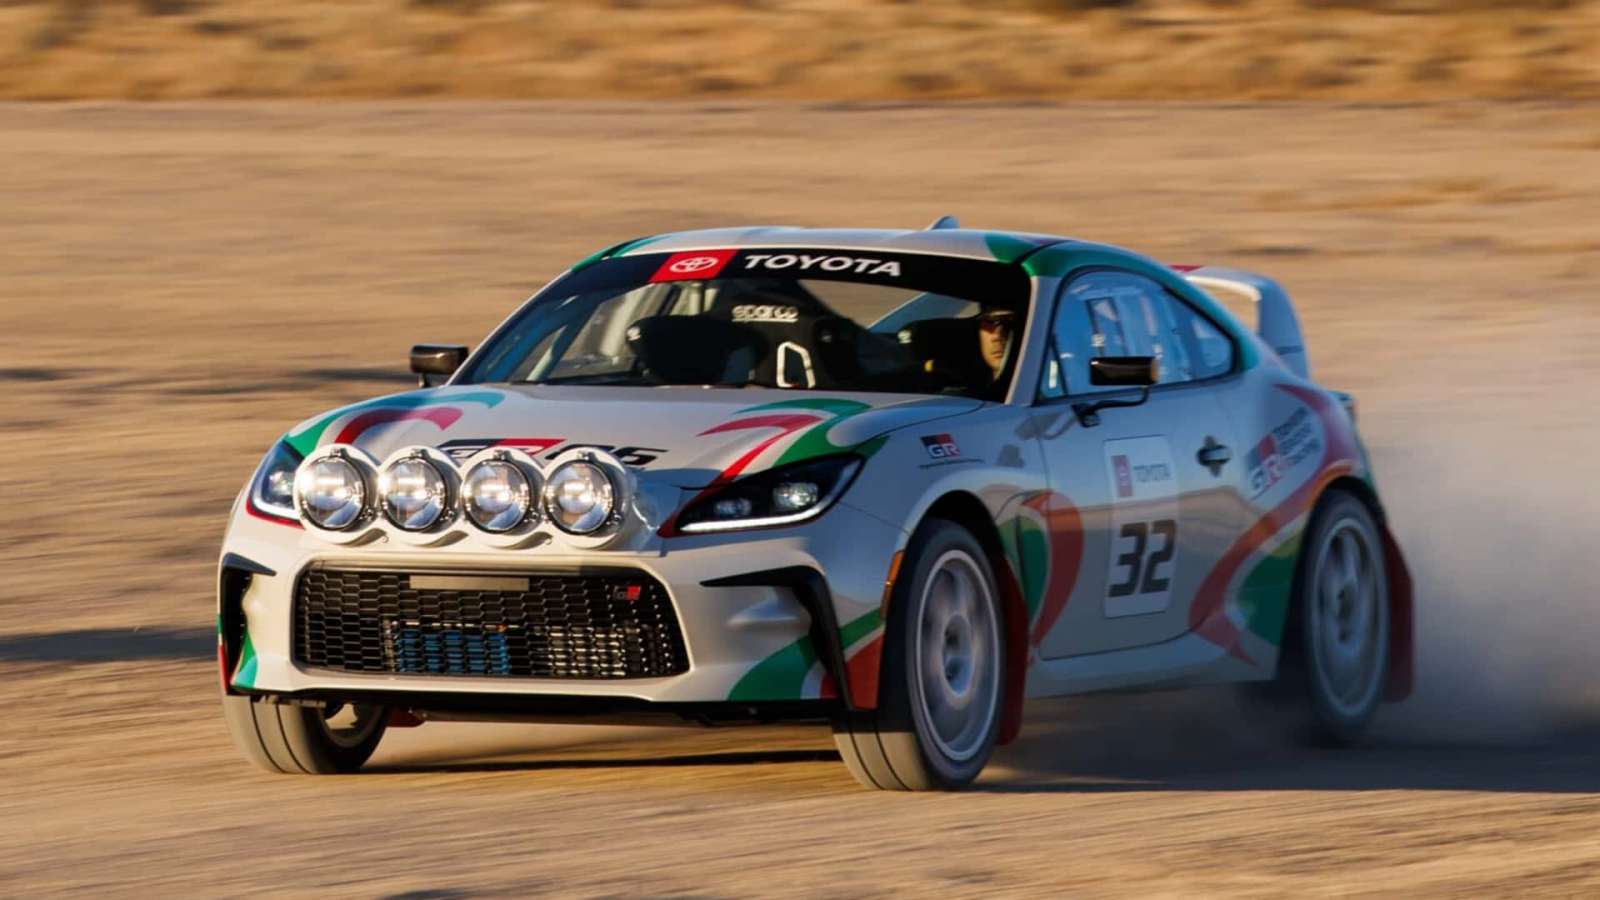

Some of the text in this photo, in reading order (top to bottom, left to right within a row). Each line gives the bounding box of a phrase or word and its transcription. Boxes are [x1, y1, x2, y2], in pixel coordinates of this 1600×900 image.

[744, 254, 902, 277] TOYOTA
[732, 304, 797, 322] sparco
[928, 443, 960, 459] GR
[1108, 520, 1177, 597] 32
